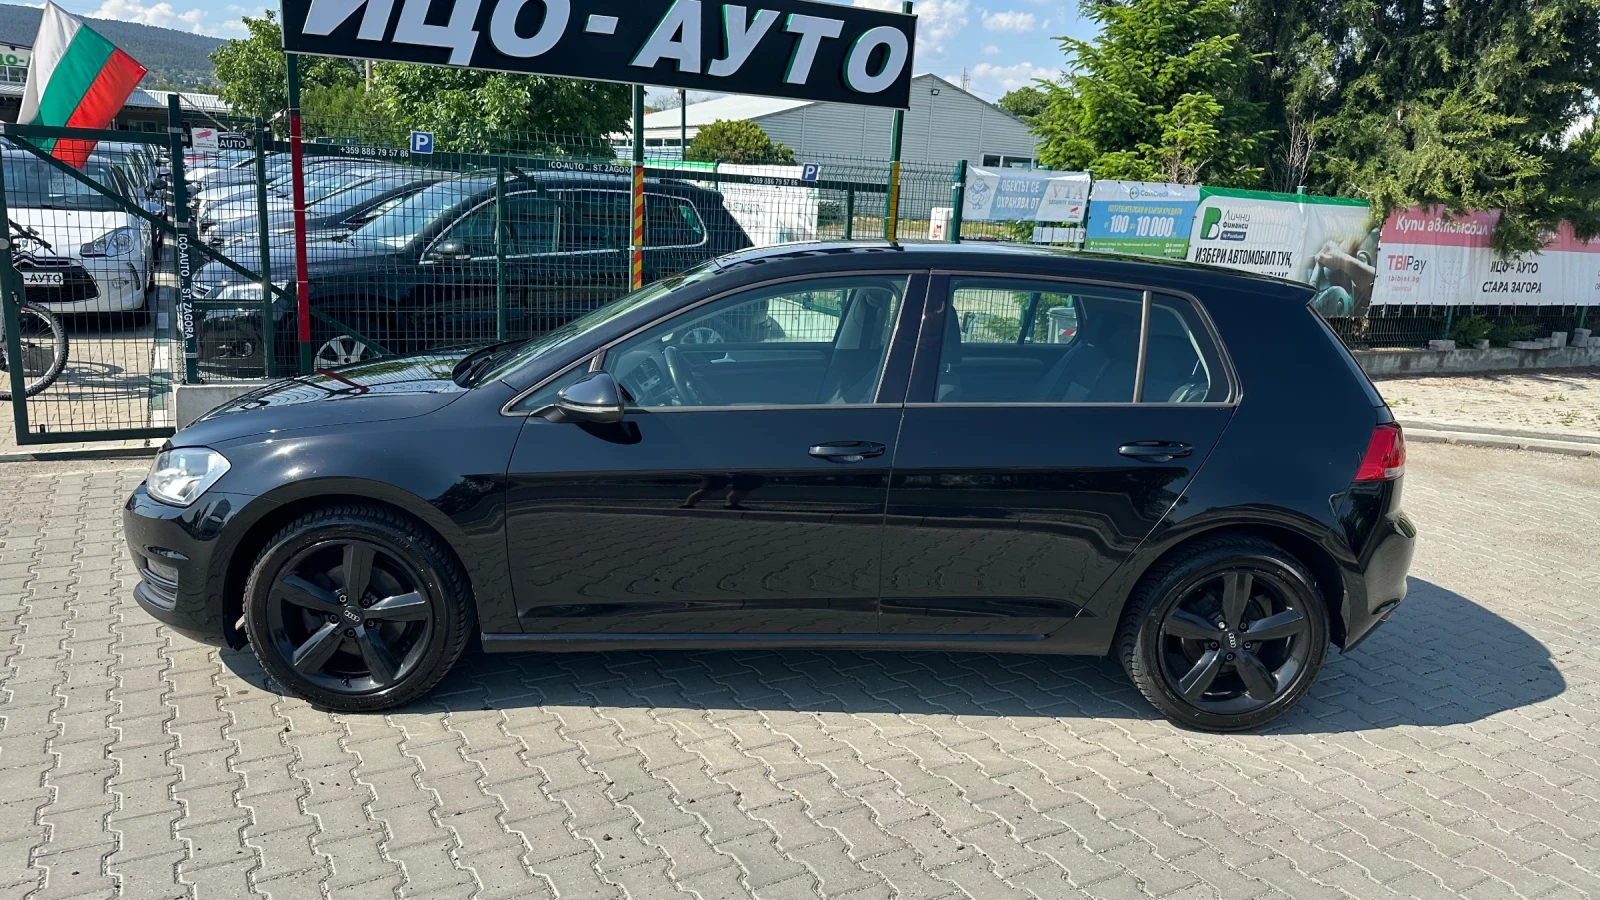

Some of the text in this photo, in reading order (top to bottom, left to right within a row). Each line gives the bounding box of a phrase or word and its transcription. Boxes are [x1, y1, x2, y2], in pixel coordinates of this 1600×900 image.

[629, 0, 909, 93] АУТО
[415, 134, 429, 151] P
[340, 146, 359, 154] +359
[361, 148, 376, 156] 886
[388, 149, 398, 157] 57
[804, 165, 815, 179] P
[1001, 180, 1040, 193] ОБЕКТЪТ СЕ
[1052, 184, 1084, 200] VTA
[996, 196, 1041, 209] ОХРАНЯВА ОТ
[1109, 214, 1130, 233] 100
[1223, 209, 1251, 222] Лични
[1395, 215, 1425, 234] Купи
[1194, 247, 1292, 268] ИЗБЕРИ АВТОМОБИЛ ТУК,
[1387, 255, 1427, 275] TBIPay
[1490, 261, 1509, 274] ИЦО
[1516, 261, 1539, 274] АУТО
[1482, 281, 1542, 294] СТАРА ЗАГОРА
[183, 302, 194, 339] ZAGORA
